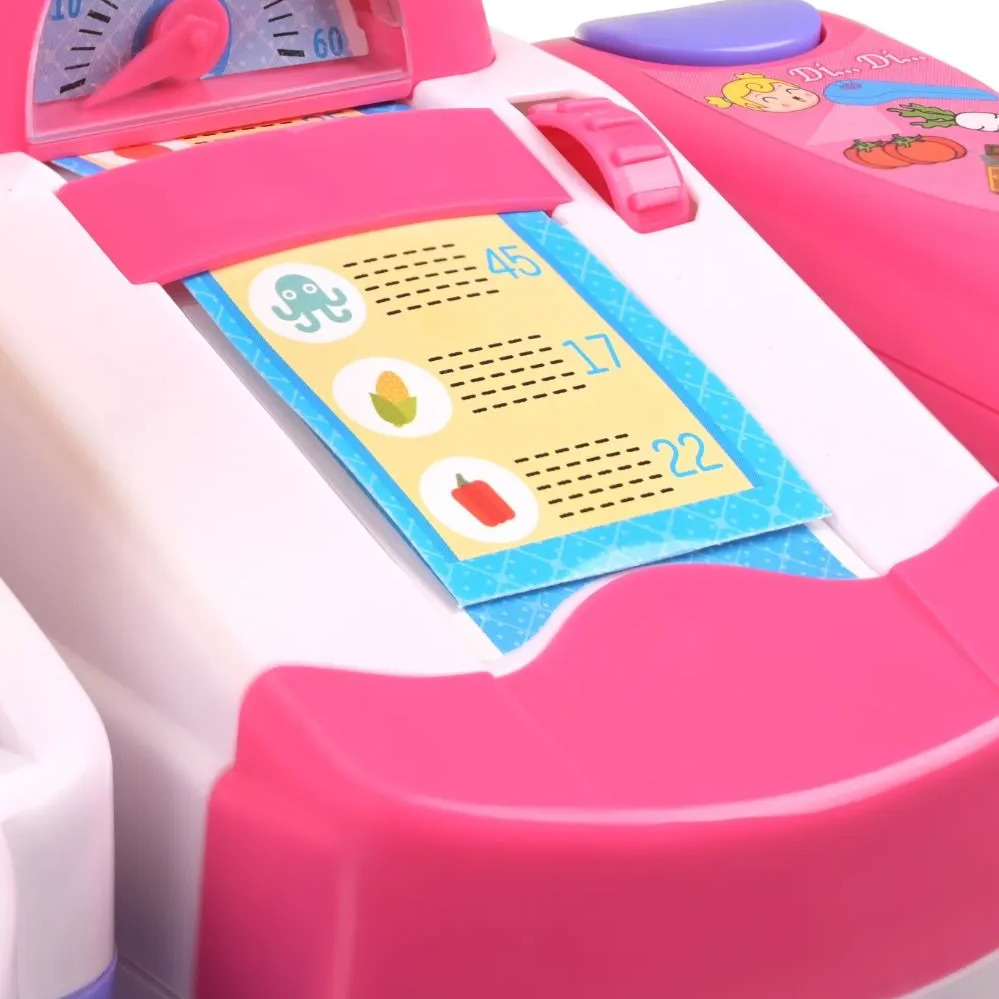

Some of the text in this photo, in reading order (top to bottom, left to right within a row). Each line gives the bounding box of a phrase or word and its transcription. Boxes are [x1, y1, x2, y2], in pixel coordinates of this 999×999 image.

[313, 28, 344, 59] 60
[485, 245, 543, 279] 45
[562, 333, 622, 376] 17
[651, 432, 724, 478] 22
